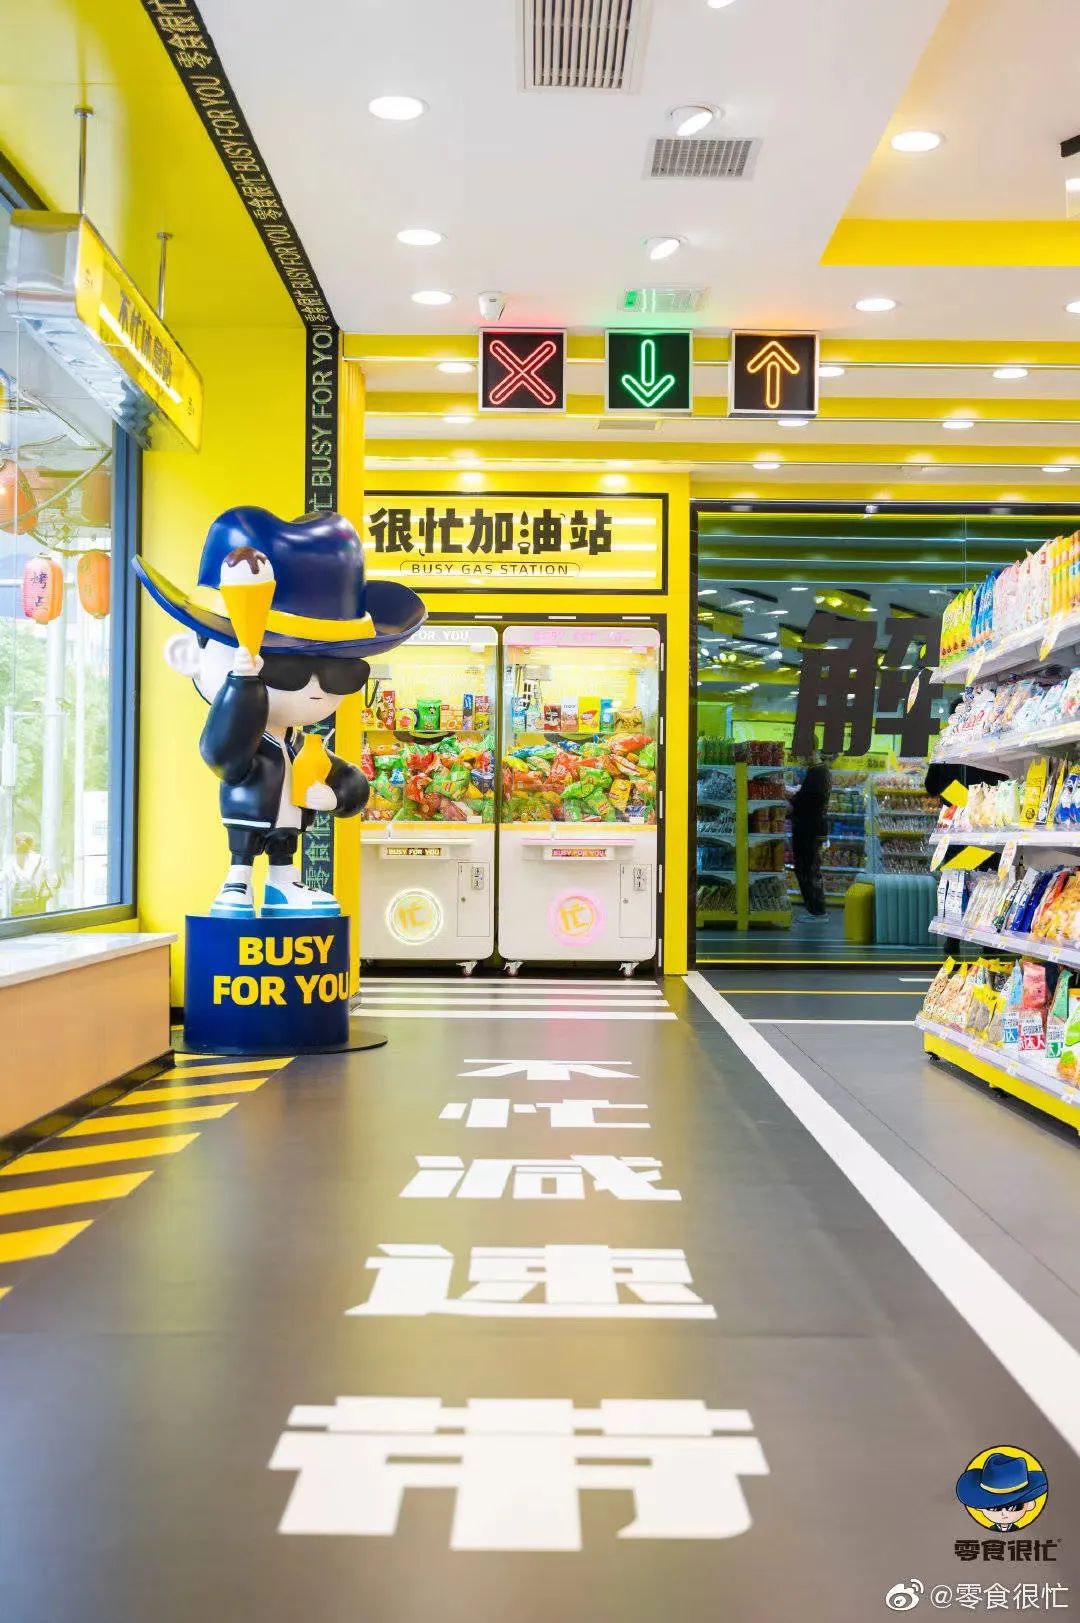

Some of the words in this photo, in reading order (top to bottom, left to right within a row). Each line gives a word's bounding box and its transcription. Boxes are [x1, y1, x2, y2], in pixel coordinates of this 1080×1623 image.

[188, 75, 230, 106] YOU
[206, 109, 245, 136] FOR
[220, 139, 261, 172] BUSY
[235, 172, 283, 220] 零食很忙
[263, 224, 295, 246] YOU
[275, 246, 304, 265] FOR
[284, 265, 314, 288] BUSY
[312, 324, 334, 365] YOU
[312, 369, 333, 419] FOR
[311, 424, 333, 487] BUSY
[368, 507, 613, 556] 很忙加油站
[412, 563, 454, 575] BUSY
[461, 563, 494, 575] GAS
[500, 563, 568, 576] STATION
[442, 630, 469, 641] YOU
[591, 849, 605, 857] YOU
[398, 903, 432, 929] 忙
[559, 903, 591, 930] 忙
[238, 935, 335, 966] BUSY
[213, 975, 288, 1006] FOR
[295, 971, 349, 1004] YOU
[268, 1058, 770, 1552] 不忙减速带
